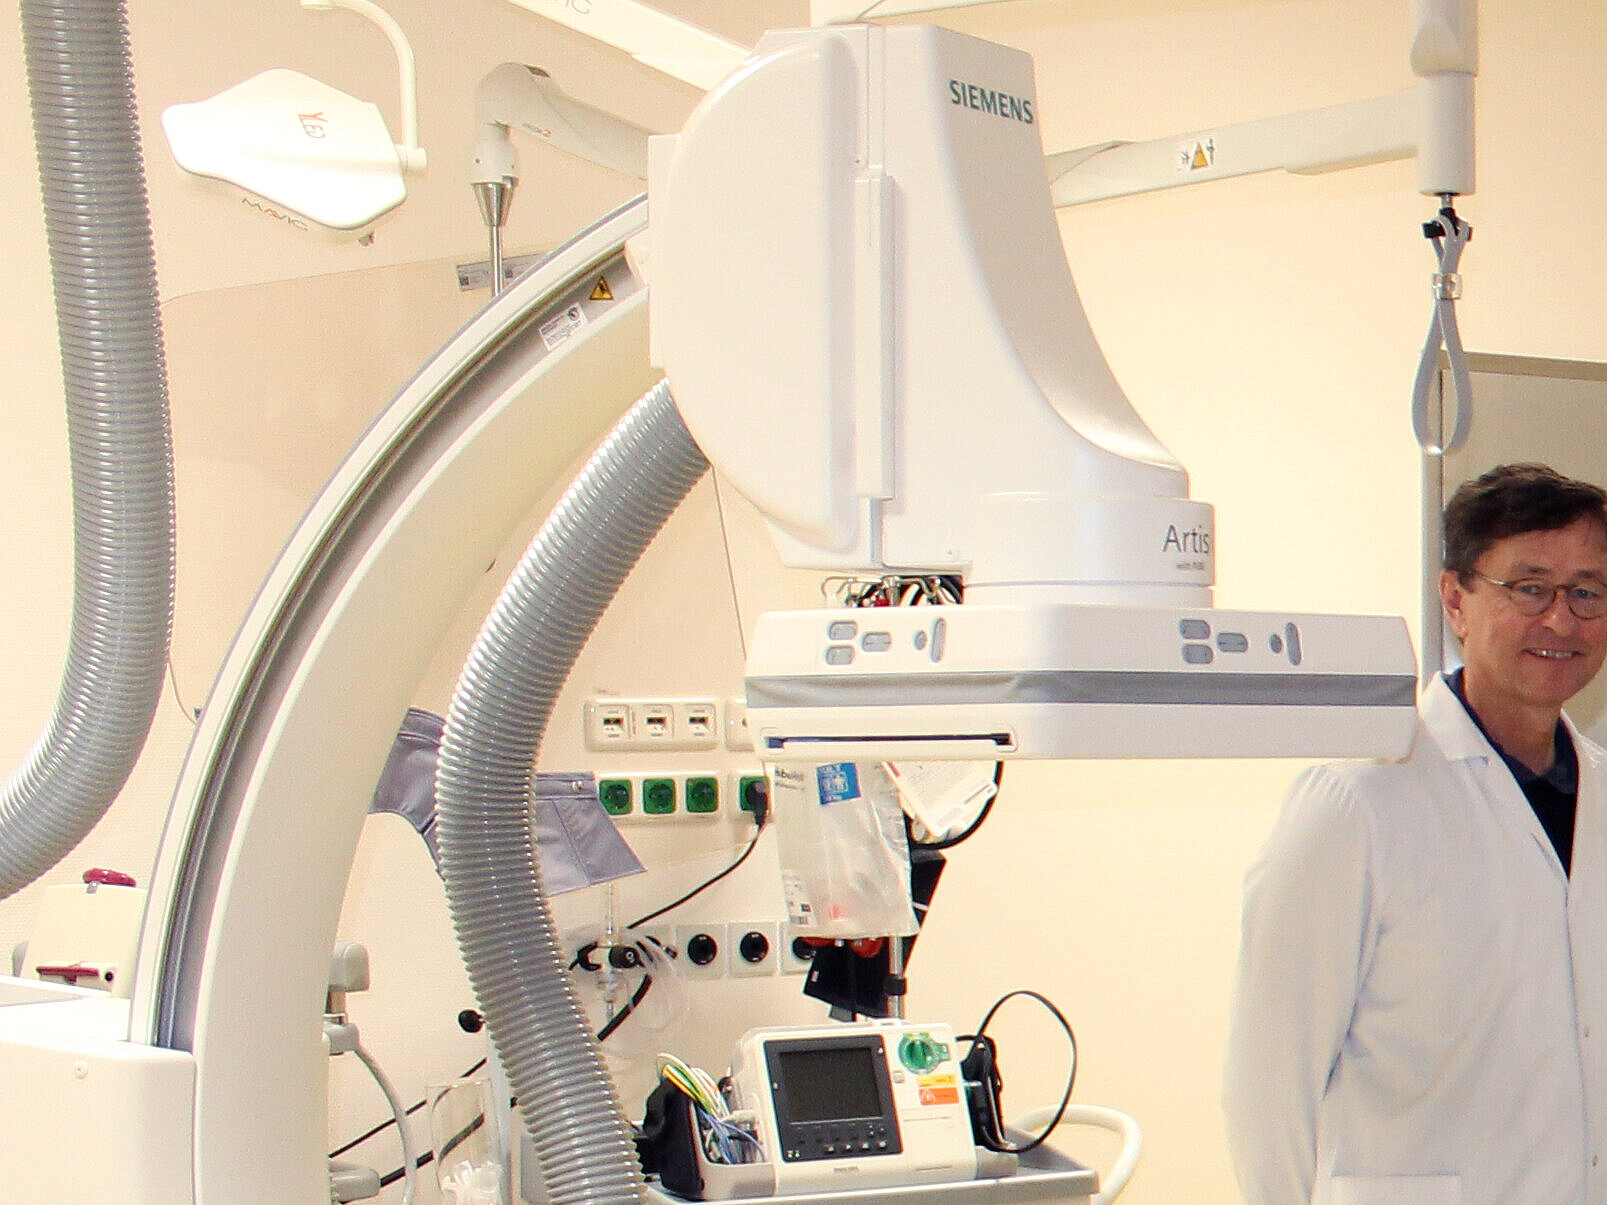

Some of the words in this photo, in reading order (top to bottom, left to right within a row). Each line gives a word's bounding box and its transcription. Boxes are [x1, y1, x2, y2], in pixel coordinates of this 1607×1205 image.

[949, 79, 1034, 124] SIEMENS
[241, 198, 308, 232] MAVIG
[1162, 524, 1210, 554] Artis
